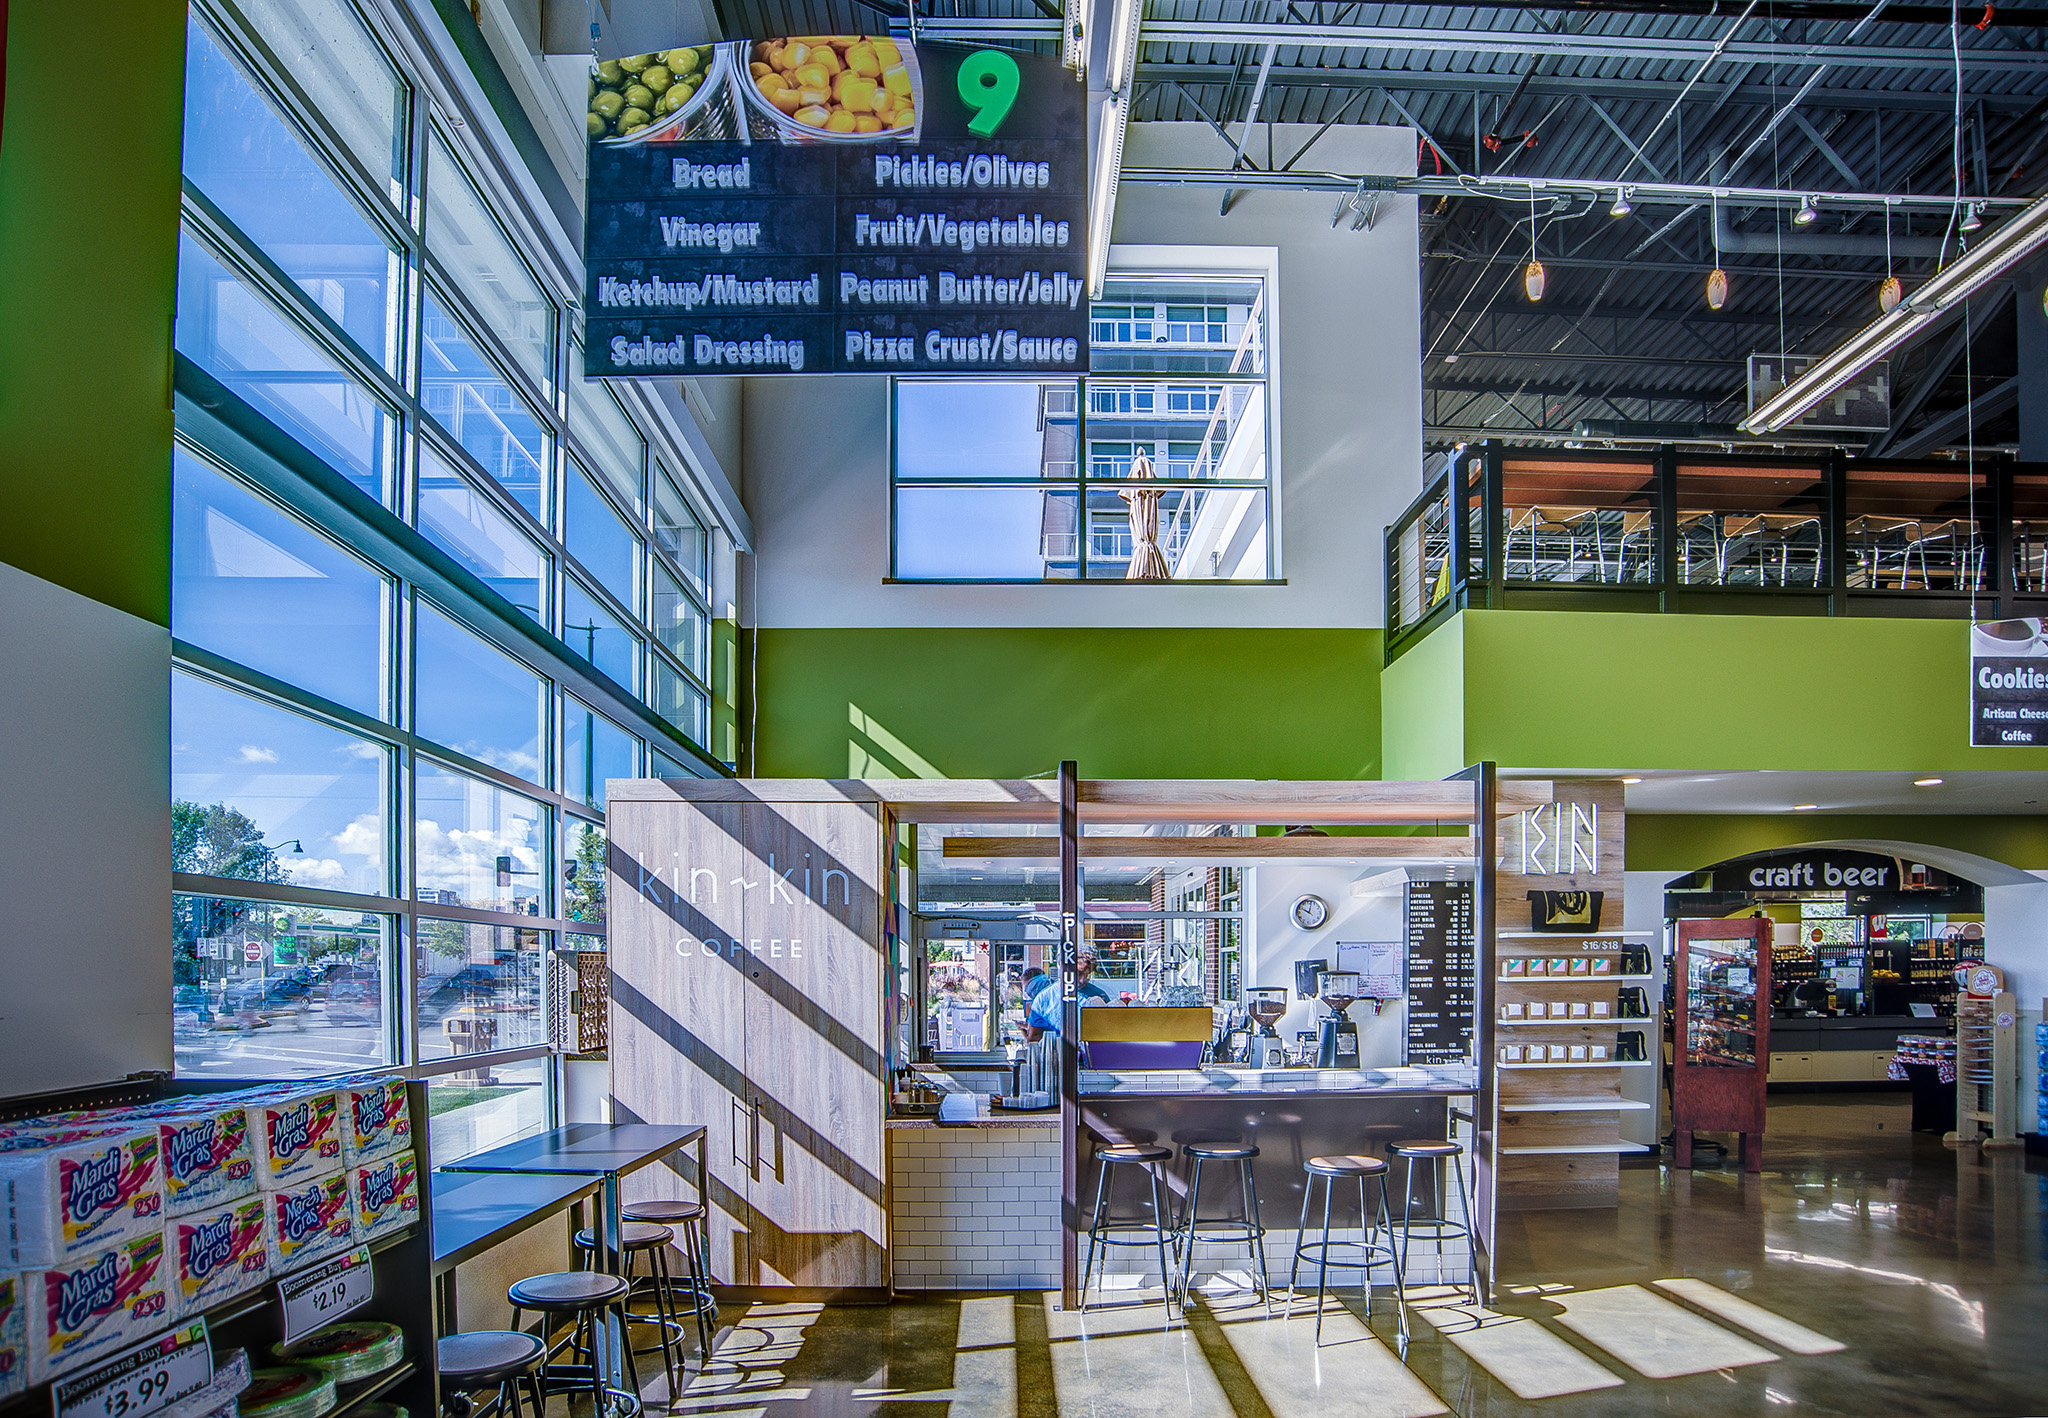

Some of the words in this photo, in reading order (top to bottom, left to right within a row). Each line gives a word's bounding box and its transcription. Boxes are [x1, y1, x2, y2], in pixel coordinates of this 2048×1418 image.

[957, 50, 1020, 138] 9
[672, 156, 750, 189] Bread
[875, 154, 1050, 189] Pickles/Olives
[659, 216, 761, 253] Vinegar
[855, 213, 1070, 253] Fruit/Vegetables
[598, 273, 820, 308] Ketchup/Mustard
[840, 272, 929, 304] Peanut
[939, 271, 1084, 310] Butter/Jelly
[610, 335, 685, 366] Salad
[694, 333, 804, 371] Dressing
[845, 330, 914, 362] Pizza
[924, 330, 1079, 364] Crust/Sauce
[1983, 708, 2017, 719] Artisan
[2001, 730, 2032, 741] Coffee
[1520, 801, 1600, 876] KIN
[1749, 862, 1814, 888] craft
[1822, 862, 1888, 888] beer
[676, 938, 803, 959] COFFEE
[1063, 919, 1076, 964] PICK
[1582, 941, 1619, 951] $16/$18
[1064, 972, 1076, 995] UP
[358, 1087, 385, 1118] Mardi
[275, 1105, 307, 1143] Mardi
[360, 1107, 385, 1134] Gras
[172, 1121, 214, 1162] Mardi
[278, 1129, 307, 1157] Gras
[319, 1142, 339, 1158] 250
[70, 1149, 119, 1202] Mardi
[176, 1143, 211, 1178] Gras
[227, 1161, 250, 1180] 250
[366, 1163, 393, 1194] Mardi
[76, 1177, 116, 1217] Gras
[133, 1193, 160, 1218] 250
[285, 1186, 321, 1225] Mardi
[369, 1183, 393, 1210] Gras
[189, 1215, 231, 1261] Mardi
[289, 1207, 319, 1239] Gras
[194, 1240, 231, 1276] Gras
[242, 1251, 266, 1273] 250
[60, 1254, 117, 1317] Mardi
[283, 1267, 328, 1295] Boomerang
[327, 1263, 341, 1274] Buy
[66, 1281, 115, 1328] Gras
[132, 1291, 166, 1321] 250
[312, 1282, 346, 1312] $2.19
[59, 1357, 137, 1397] Boomerang
[139, 1344, 162, 1363] Buy
[109, 1367, 151, 1390] PAPER
[154, 1345, 195, 1369] PLATES
[104, 1369, 170, 1418] $3.99
